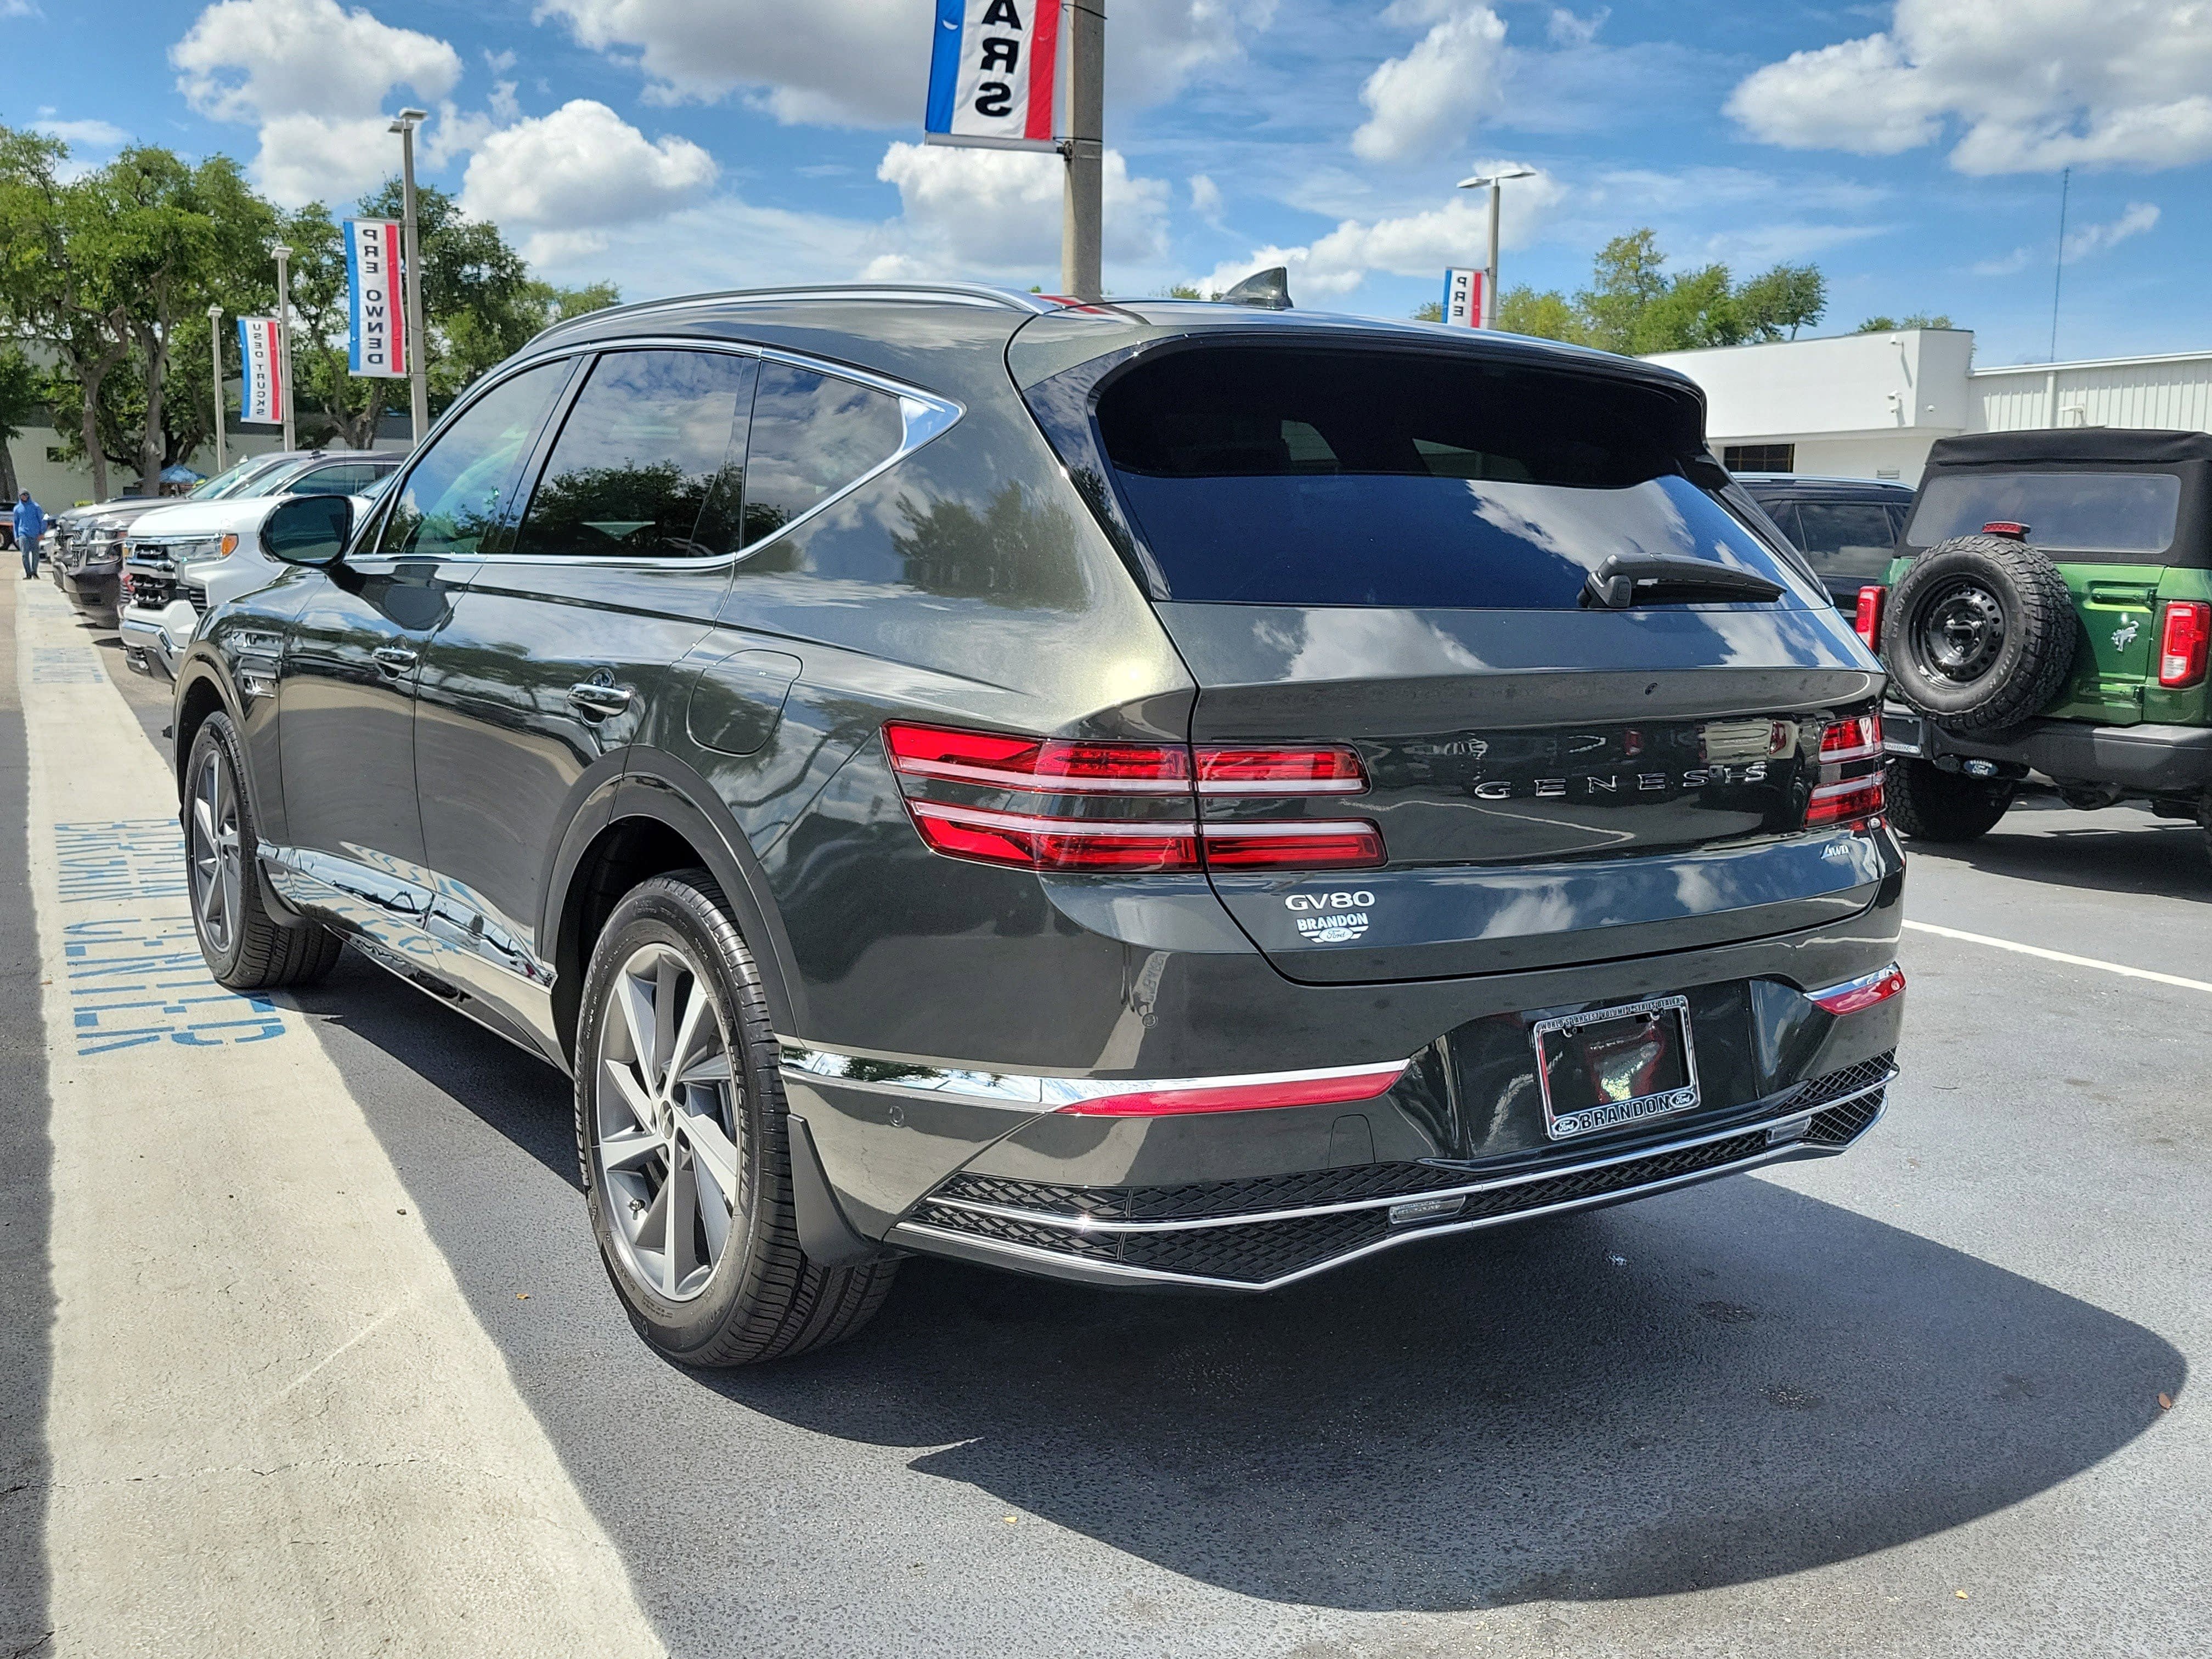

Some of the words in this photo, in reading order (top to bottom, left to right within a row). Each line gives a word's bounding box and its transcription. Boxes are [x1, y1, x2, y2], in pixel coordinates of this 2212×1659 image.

[1474, 761, 1767, 799] GENESIS
[1284, 890, 1375, 911] GV80
[1296, 912, 1369, 932] BRANDON
[1327, 929, 1346, 940] Ford
[1657, 997, 1681, 1009] DEALER
[1558, 1121, 1575, 1131] Ford
[1579, 1094, 1671, 1130] BRANDON
[1675, 1093, 1691, 1104] Ford
